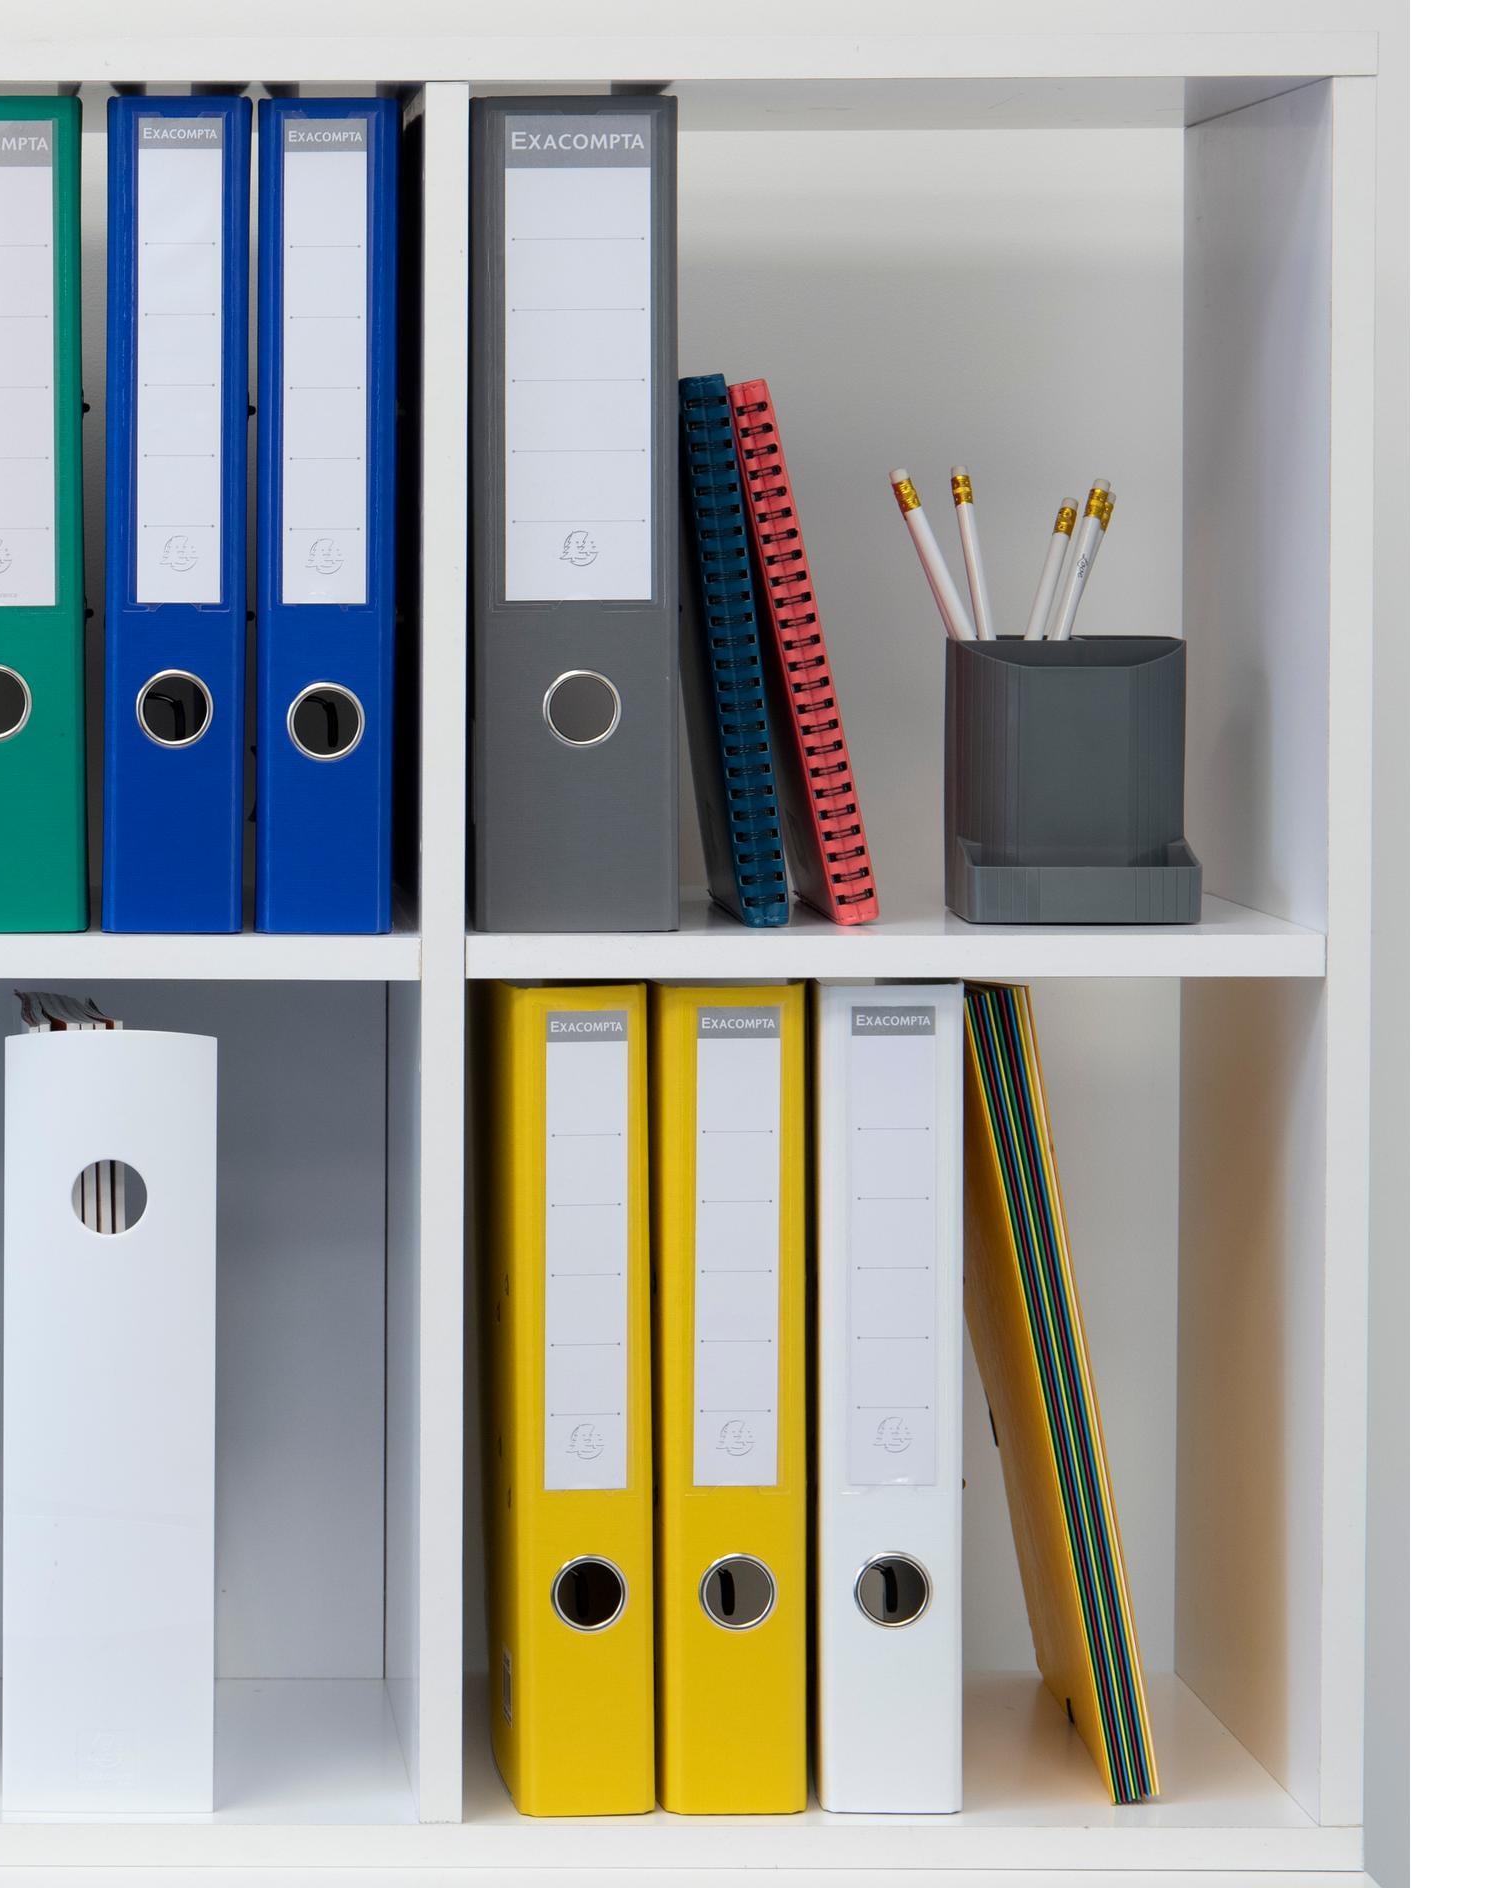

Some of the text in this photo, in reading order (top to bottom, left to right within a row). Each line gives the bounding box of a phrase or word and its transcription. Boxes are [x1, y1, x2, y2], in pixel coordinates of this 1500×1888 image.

[143, 126, 218, 140] EXACOMPTA
[288, 130, 363, 143] EXACOMPTA
[510, 131, 645, 150] EXACOMPTA
[549, 1019, 624, 1034] EXACOMPTA
[700, 1016, 776, 1030] EXACOMPTA
[855, 1013, 932, 1027] EXACOMPTA
